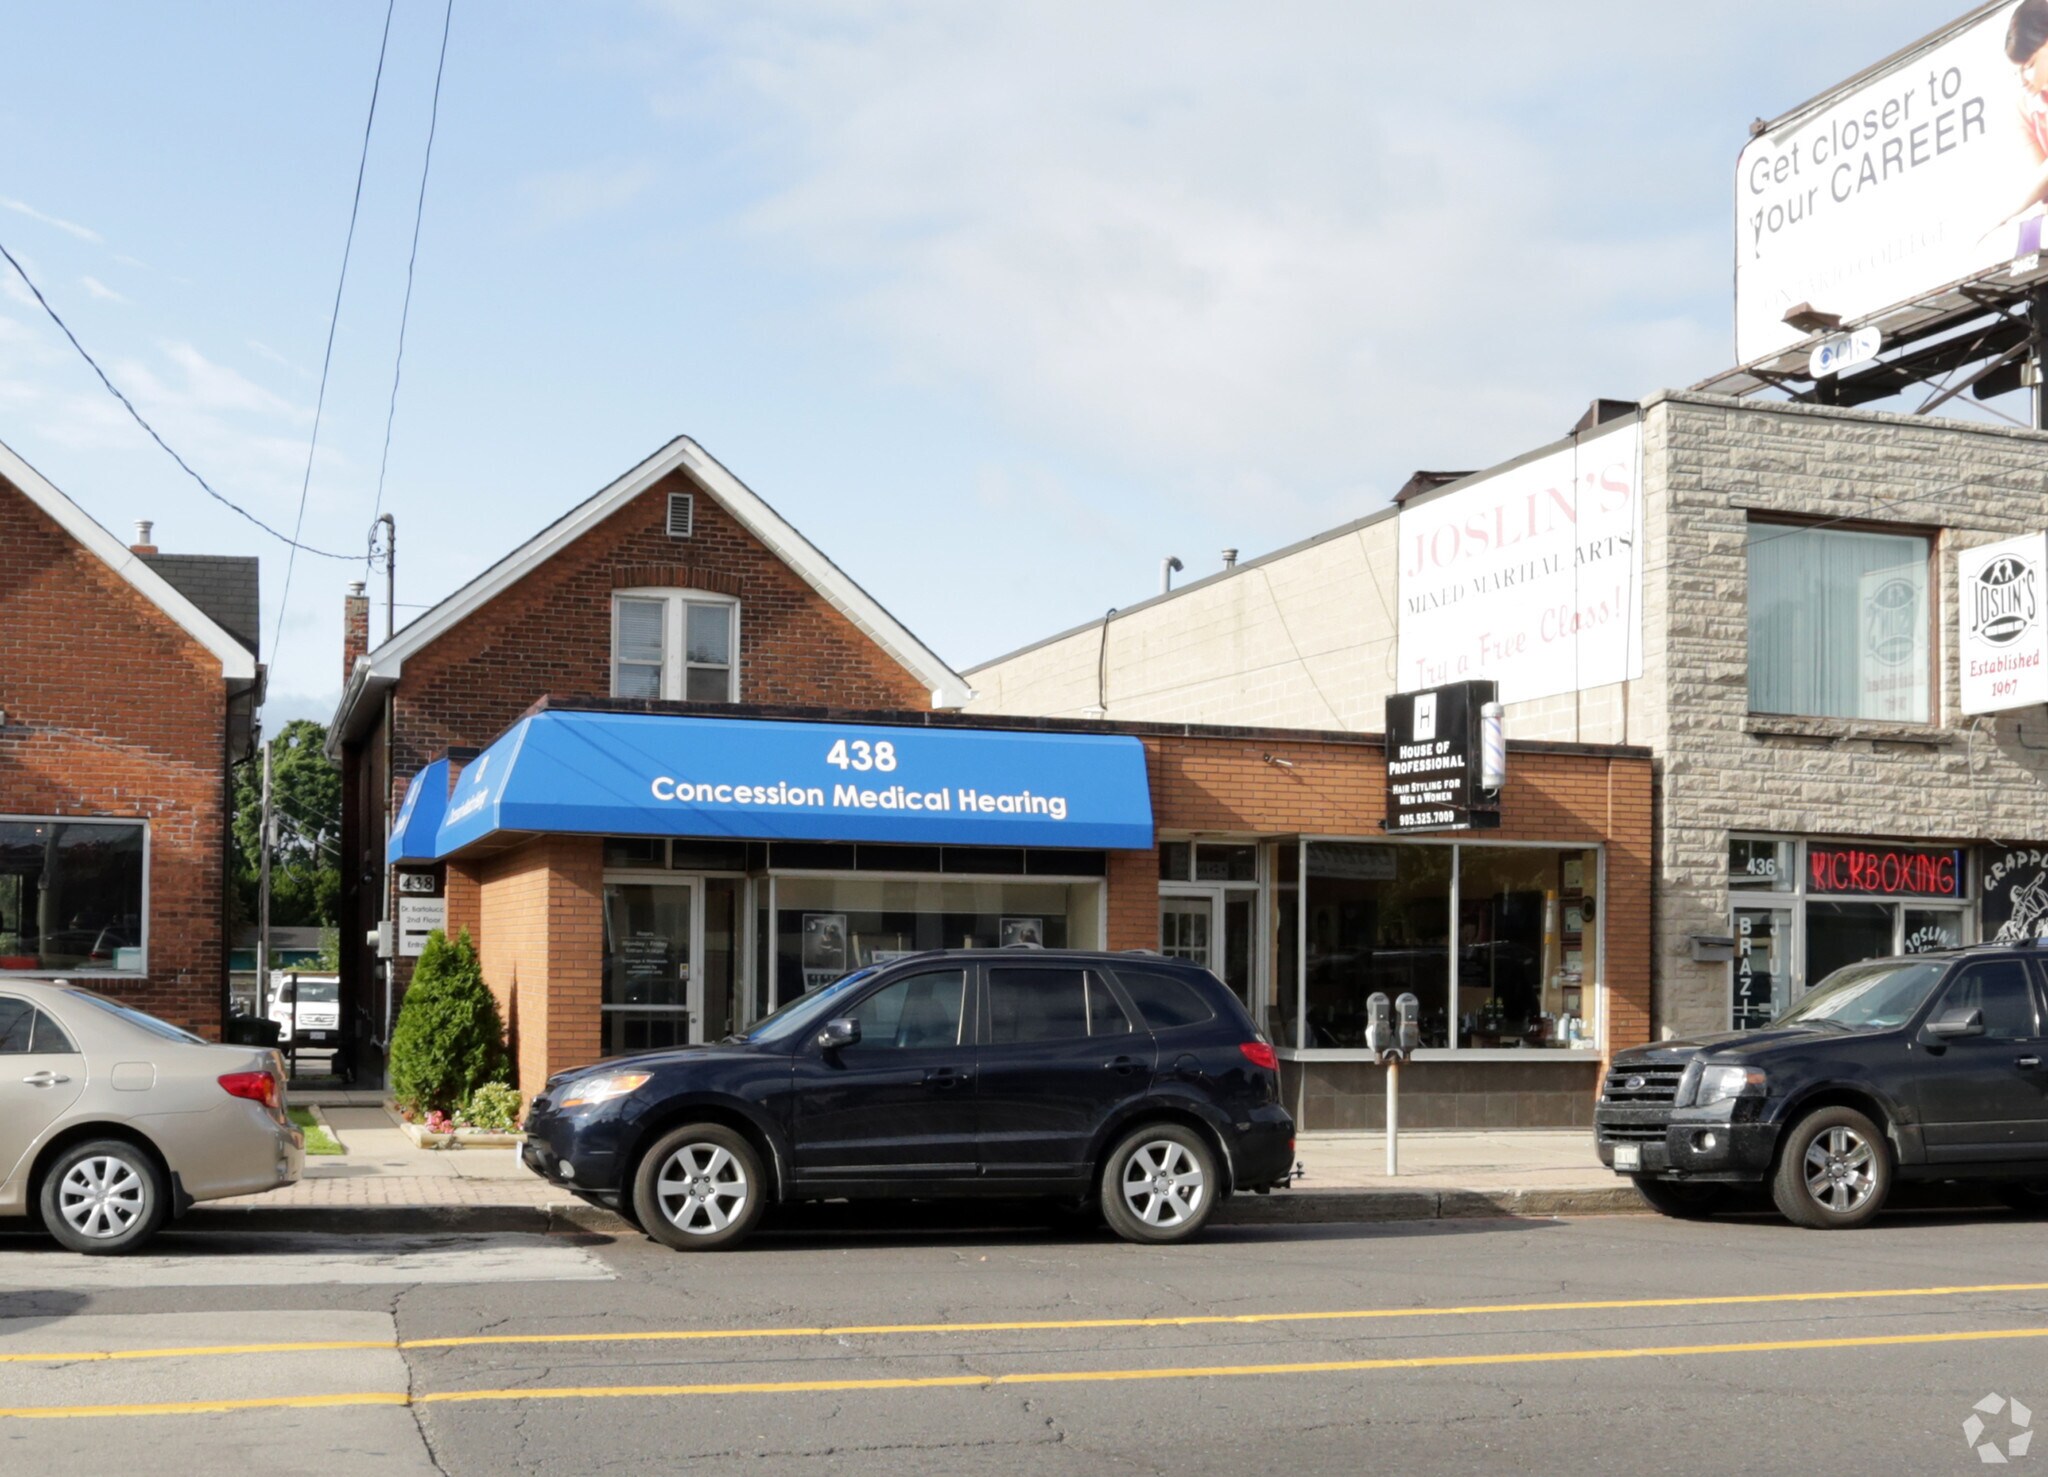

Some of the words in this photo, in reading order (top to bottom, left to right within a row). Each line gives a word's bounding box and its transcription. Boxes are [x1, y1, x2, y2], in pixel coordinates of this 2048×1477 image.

[1750, 142, 1800, 195] Get
[1812, 88, 1915, 166] closer
[1928, 66, 1962, 107] to
[1750, 186, 1818, 260] your
[1831, 96, 1986, 203] CAREER
[1408, 461, 1632, 577] JOSLIN'S
[1408, 584, 1464, 617] MIXED
[1573, 531, 1634, 569] ARTS
[1971, 568, 2037, 633] JOSLIN'S
[1416, 656, 1447, 690] Try
[1457, 653, 1469, 675] a
[1478, 631, 1527, 667] Free
[1539, 584, 1622, 644] Class!
[1969, 648, 2041, 679] Established
[1991, 678, 2019, 697] 1967
[1419, 704, 1432, 730] H
[827, 739, 897, 772] 438
[651, 776, 825, 808] Concession
[833, 783, 951, 812] Medical
[958, 788, 1067, 821] Hearing
[1399, 810, 1455, 827] 905.525.7009
[402, 875, 434, 890] 438
[1746, 858, 1776, 877] 436
[1811, 850, 1956, 894] KICKBOXING
[406, 916, 421, 924] 2nd
[423, 916, 441, 924] Floor
